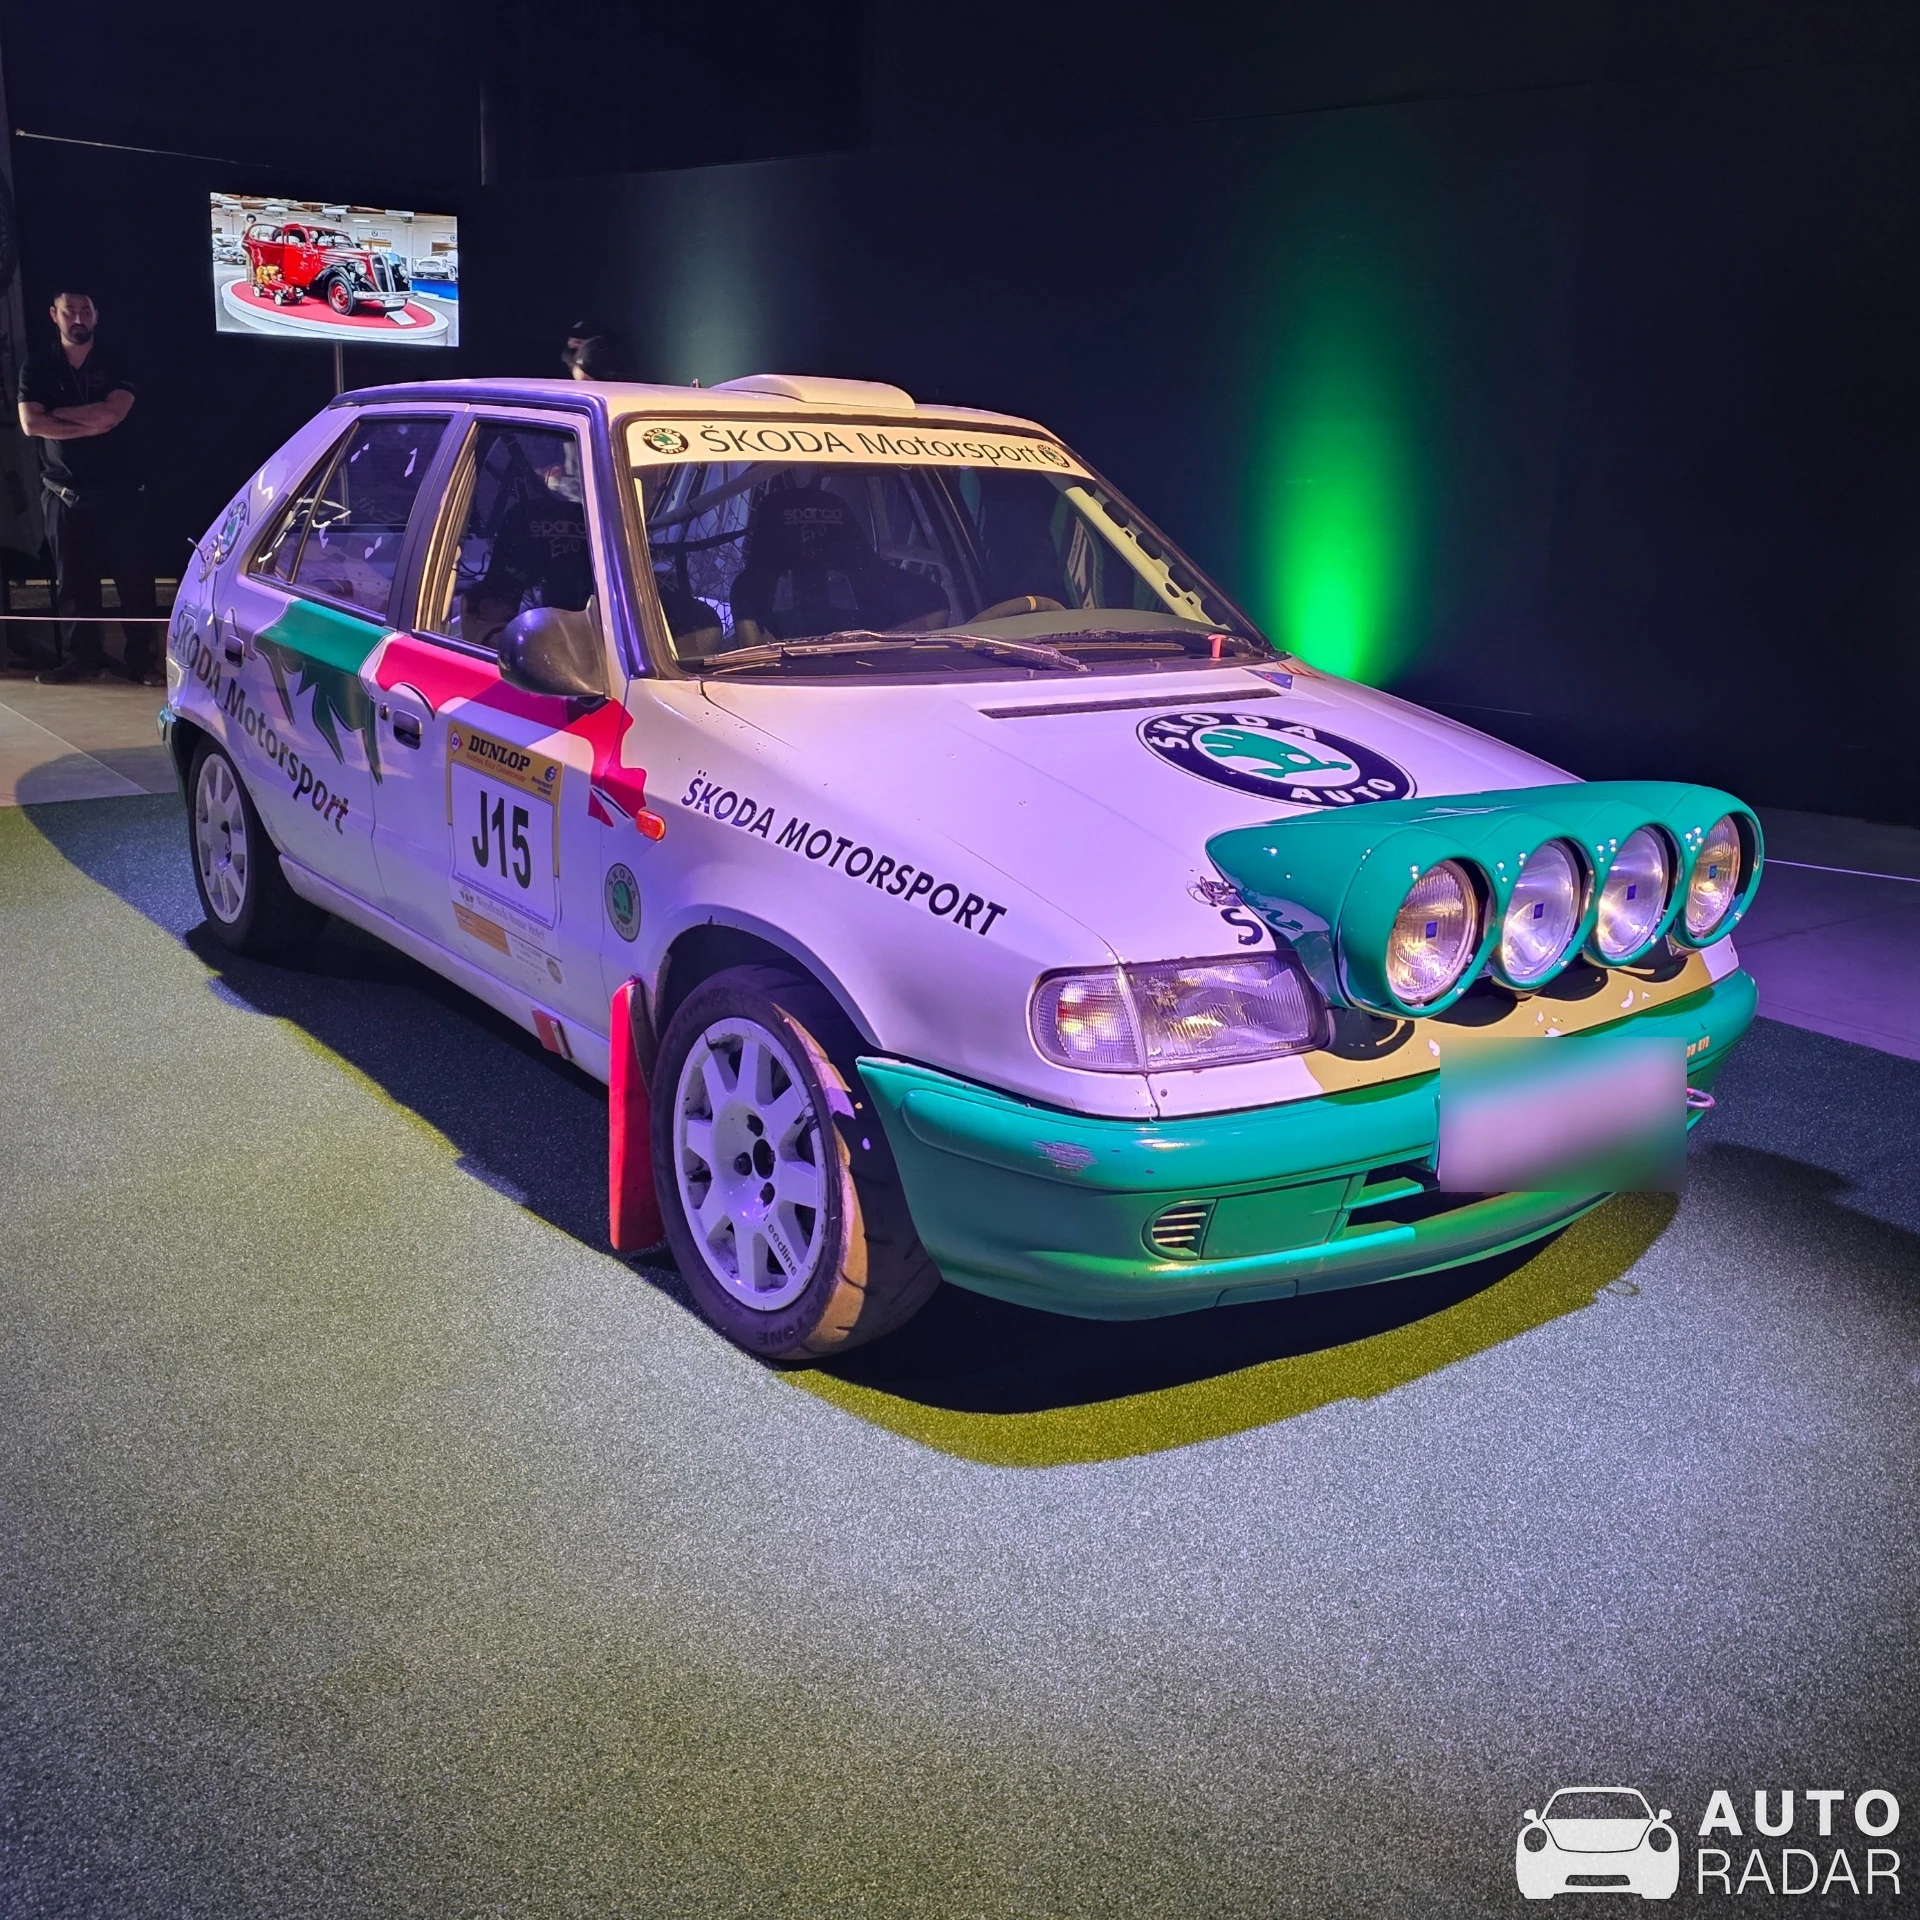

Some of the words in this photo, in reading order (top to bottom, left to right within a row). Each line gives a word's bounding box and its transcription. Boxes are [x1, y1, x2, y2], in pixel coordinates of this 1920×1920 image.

[699, 424, 855, 454] ŠKODA
[855, 432, 1046, 466] Motorsport
[529, 519, 586, 538] sparc
[1146, 713, 1318, 750] ŠKODA
[223, 678, 349, 835] Motorsport
[467, 734, 531, 772] DUNLOP
[1289, 777, 1397, 803] AUTO
[471, 789, 532, 890] J15
[774, 816, 1008, 937] MOTORSPORT
